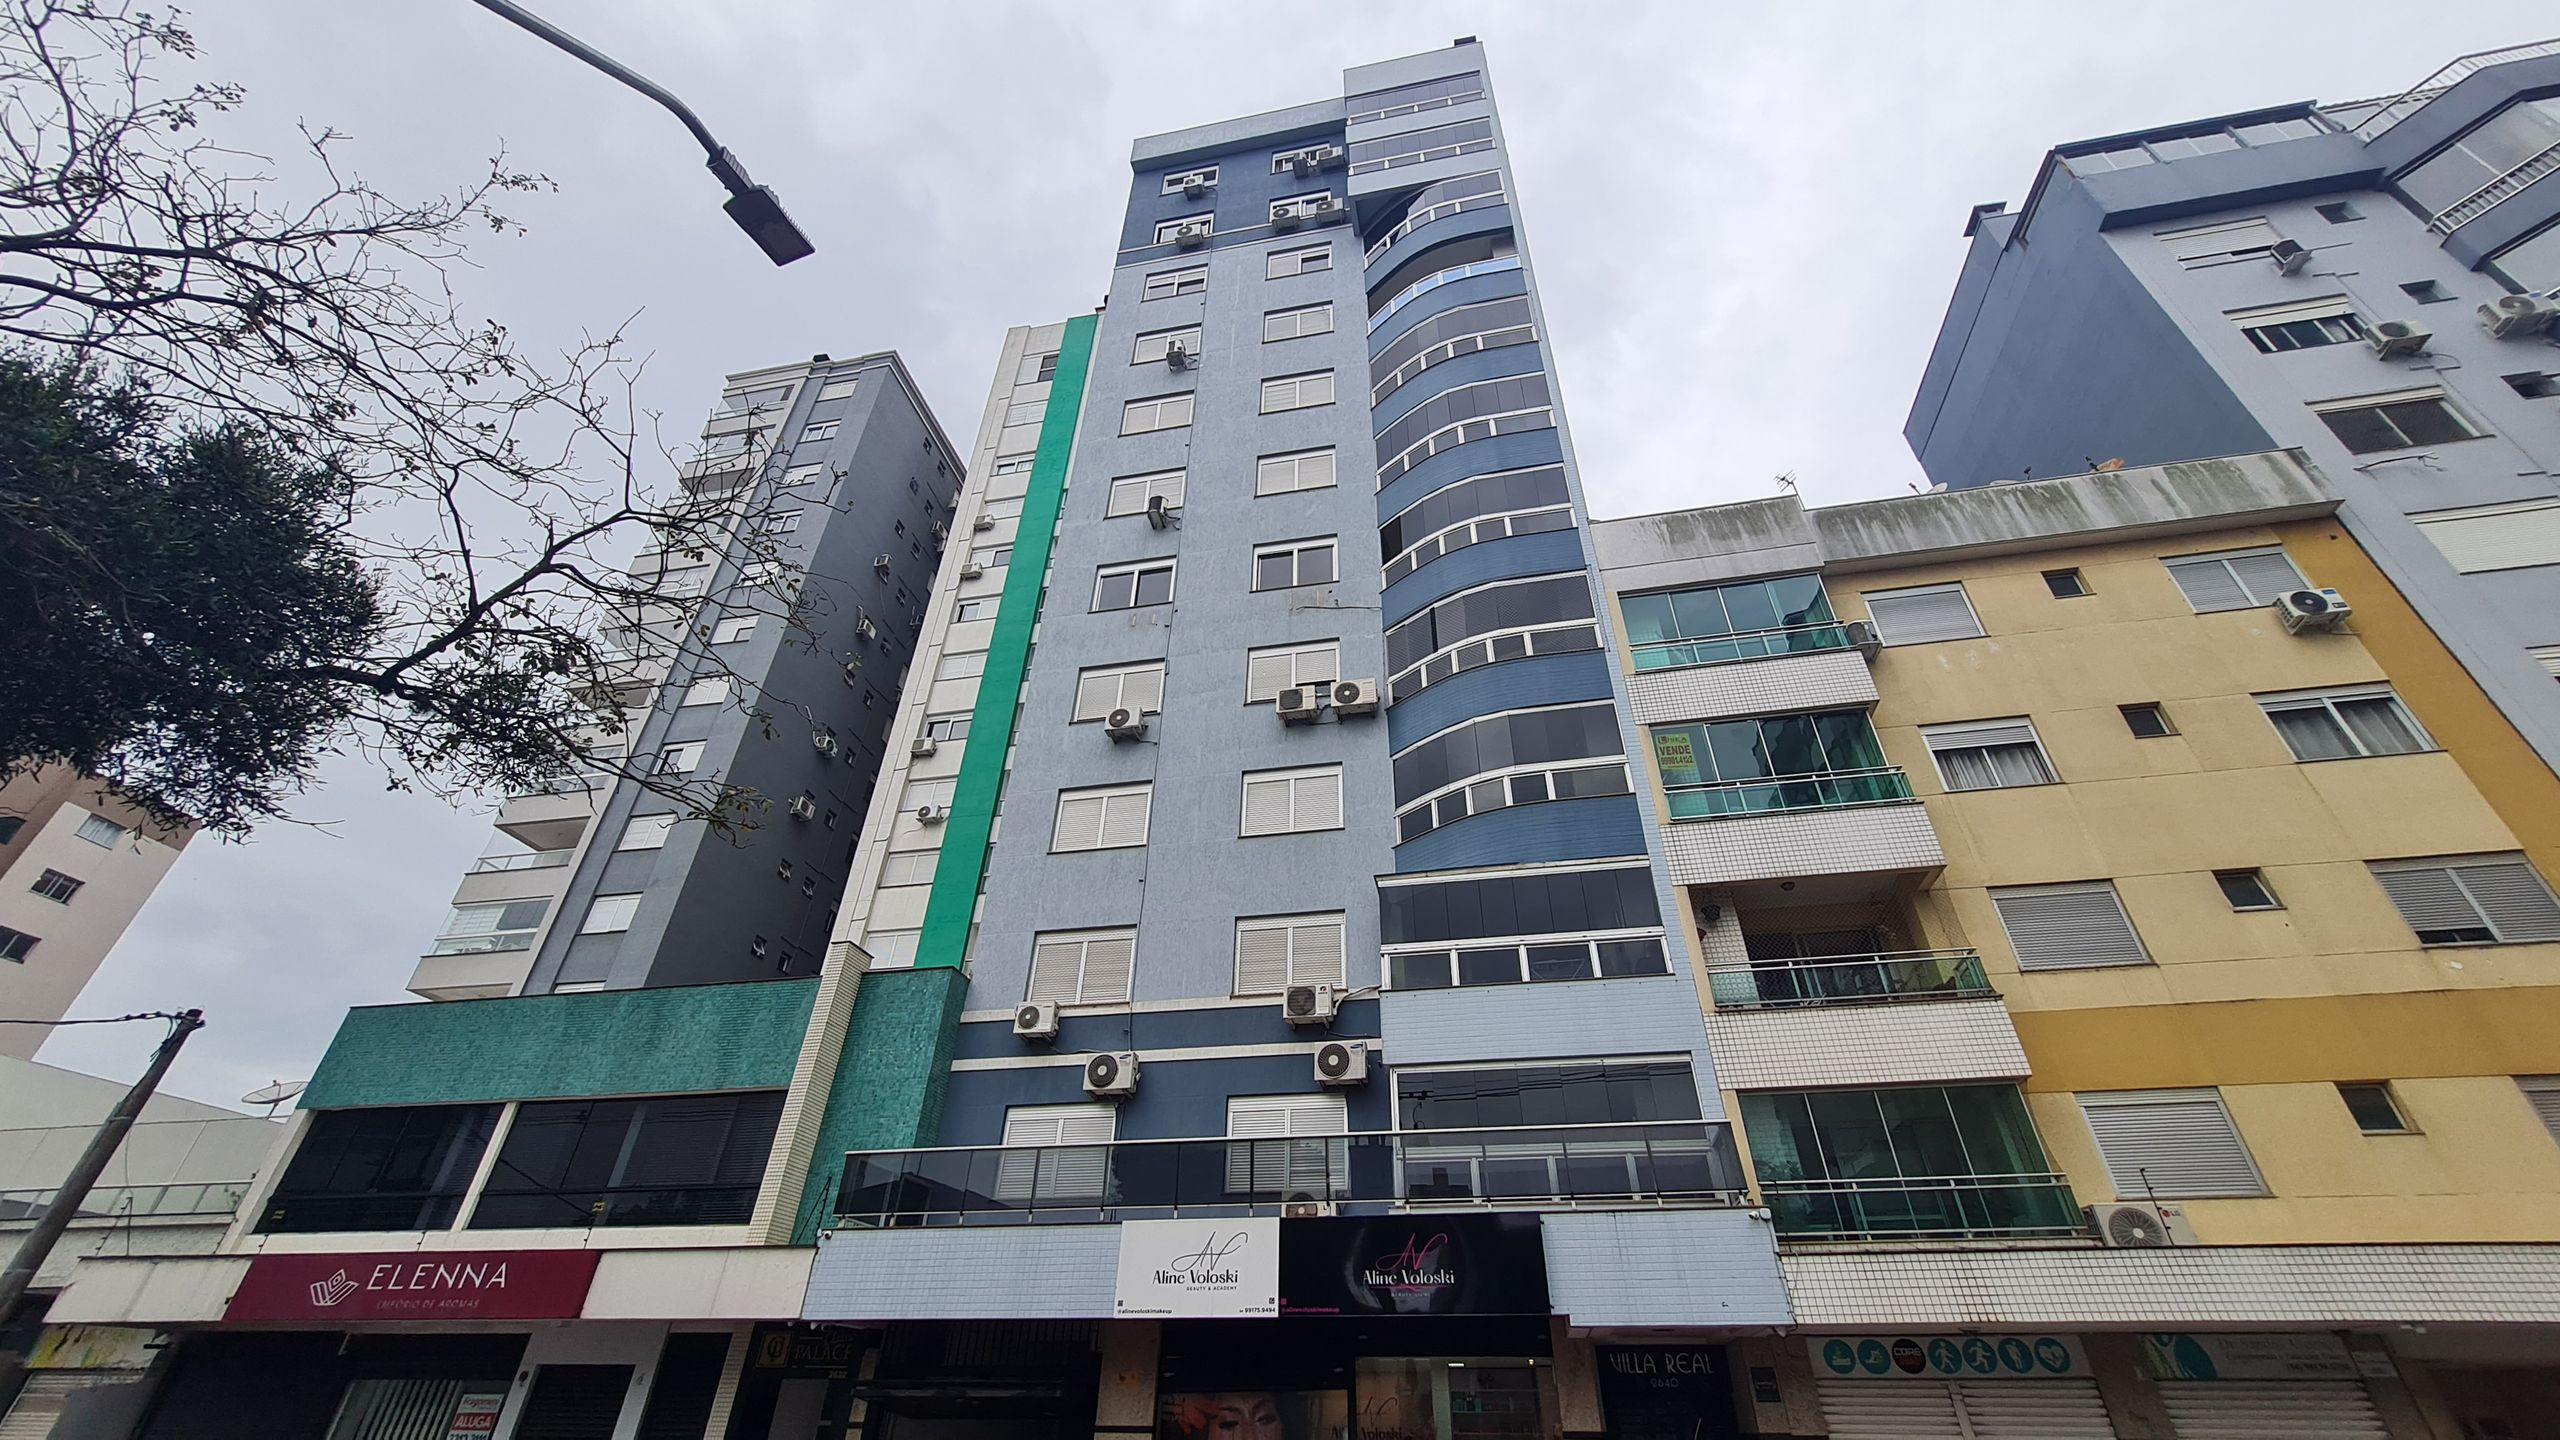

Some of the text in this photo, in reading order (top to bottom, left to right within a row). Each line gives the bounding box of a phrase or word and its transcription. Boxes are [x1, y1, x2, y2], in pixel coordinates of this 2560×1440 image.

[1659, 745, 1691, 756] VENDE
[366, 1262, 508, 1291] ELENNA
[1152, 1269, 1239, 1285] Aline Voloski
[1363, 1269, 1455, 1285] Aline Voloski
[438, 1299, 480, 1309] AROMAS
[1609, 1352, 1715, 1374] VILLA REAL
[454, 1415, 492, 1428] ALUGA
